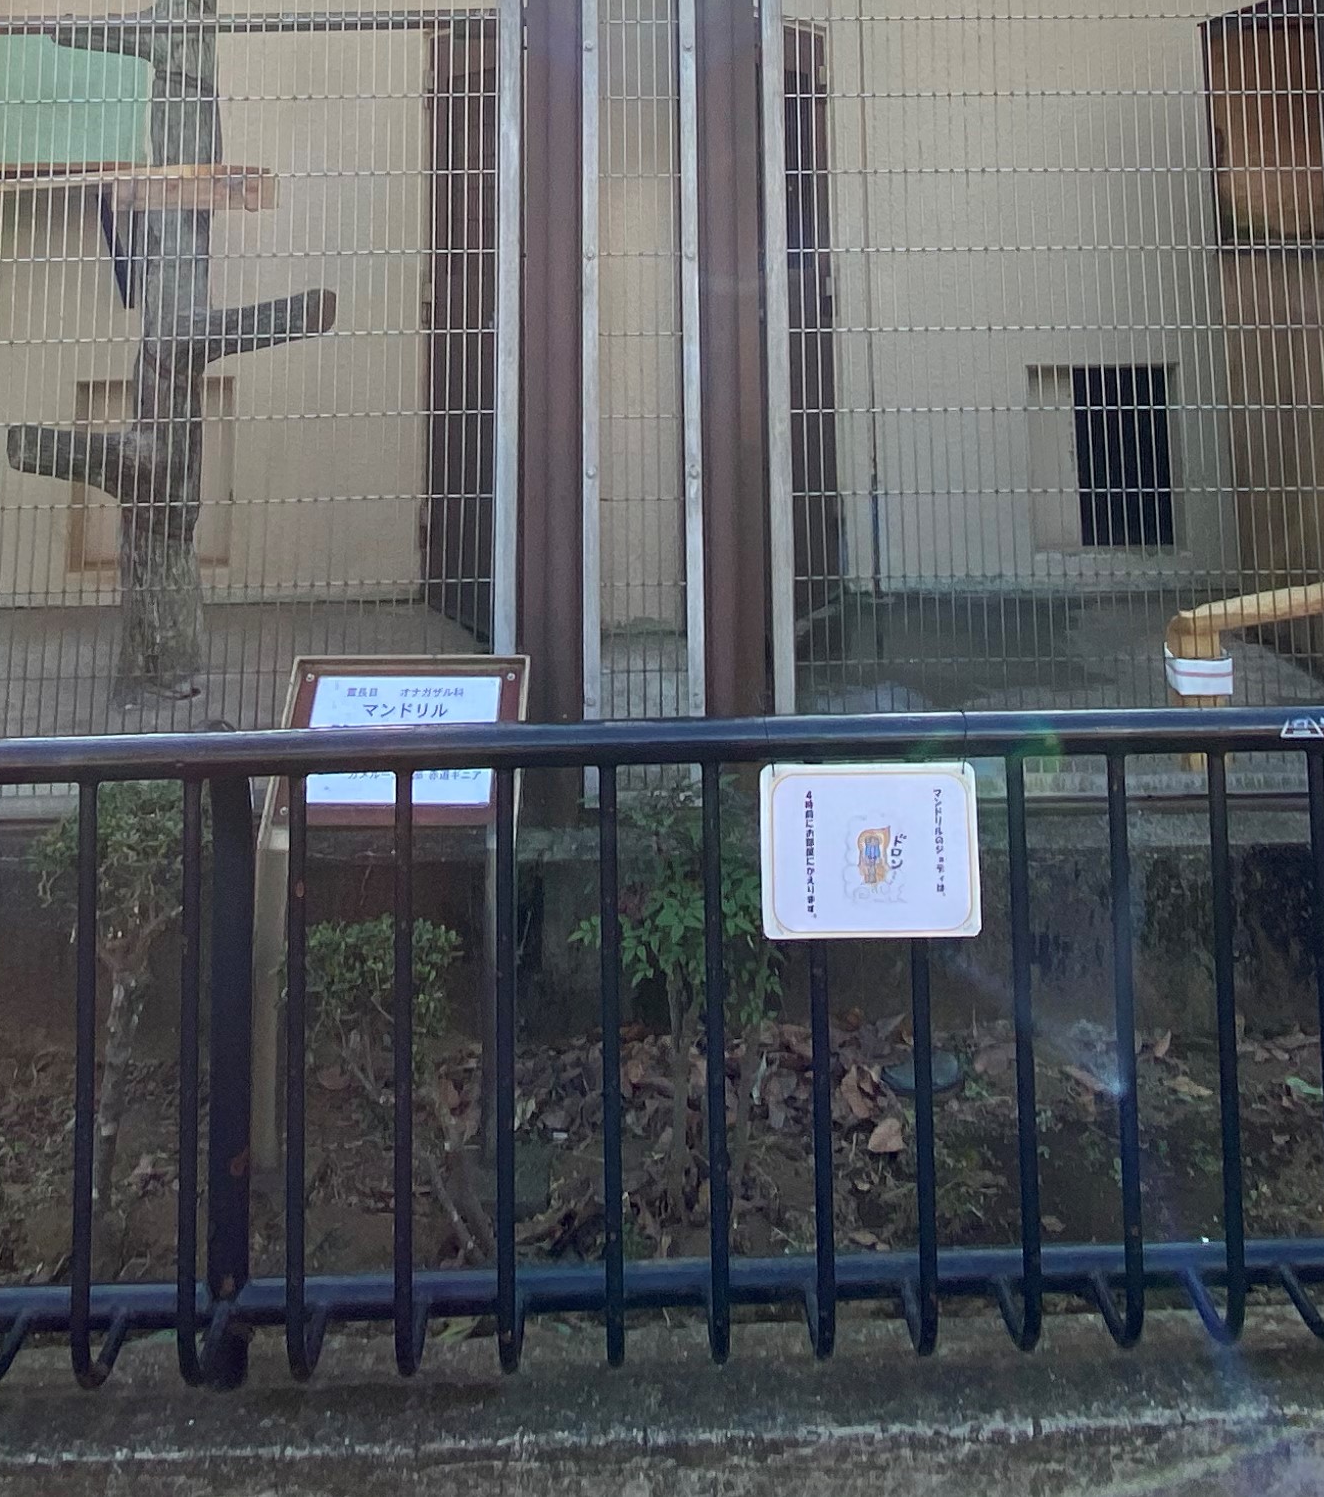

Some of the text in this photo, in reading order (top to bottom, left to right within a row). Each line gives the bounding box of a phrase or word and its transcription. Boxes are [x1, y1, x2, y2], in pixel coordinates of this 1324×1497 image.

[398, 686, 465, 699] オナガザル科
[361, 701, 449, 719] マンドリル
[889, 832, 908, 870] ドロン
